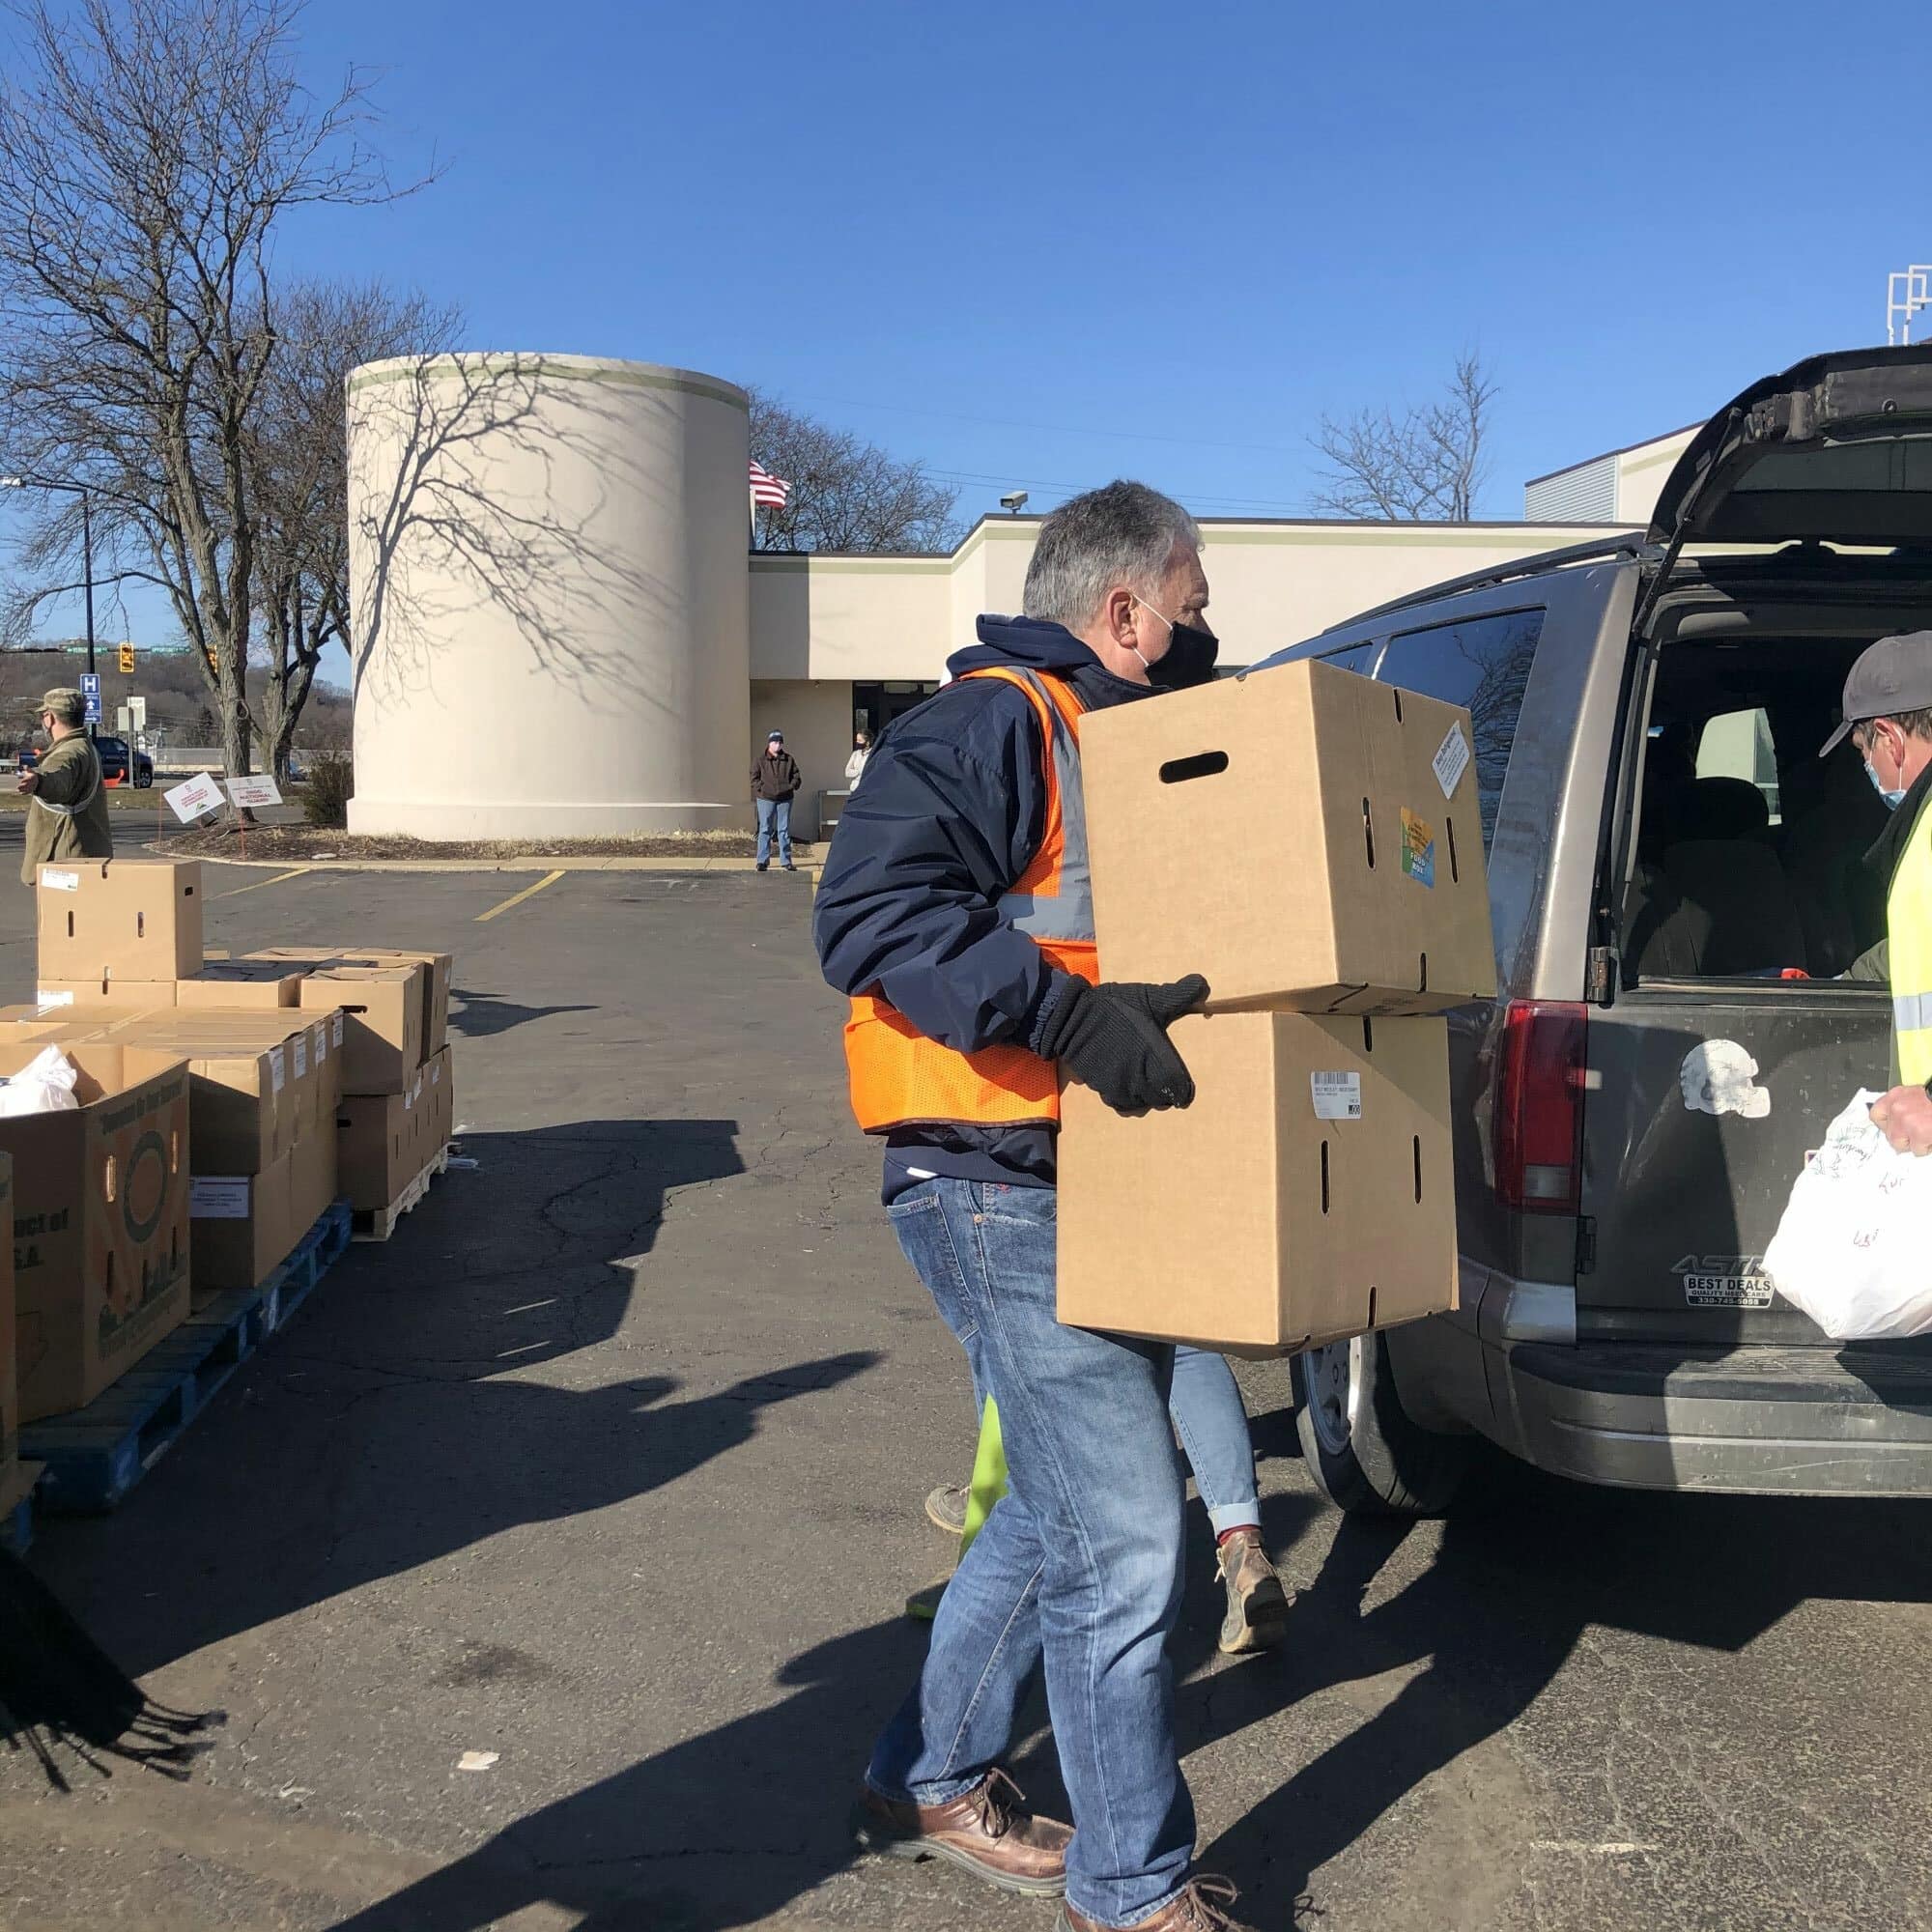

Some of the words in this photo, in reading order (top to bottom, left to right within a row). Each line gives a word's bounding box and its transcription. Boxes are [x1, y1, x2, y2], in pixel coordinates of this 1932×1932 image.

[84, 676, 97, 692] H
[1688, 1277, 1722, 1290] BEST
[1727, 1279, 1772, 1292] DEALS
